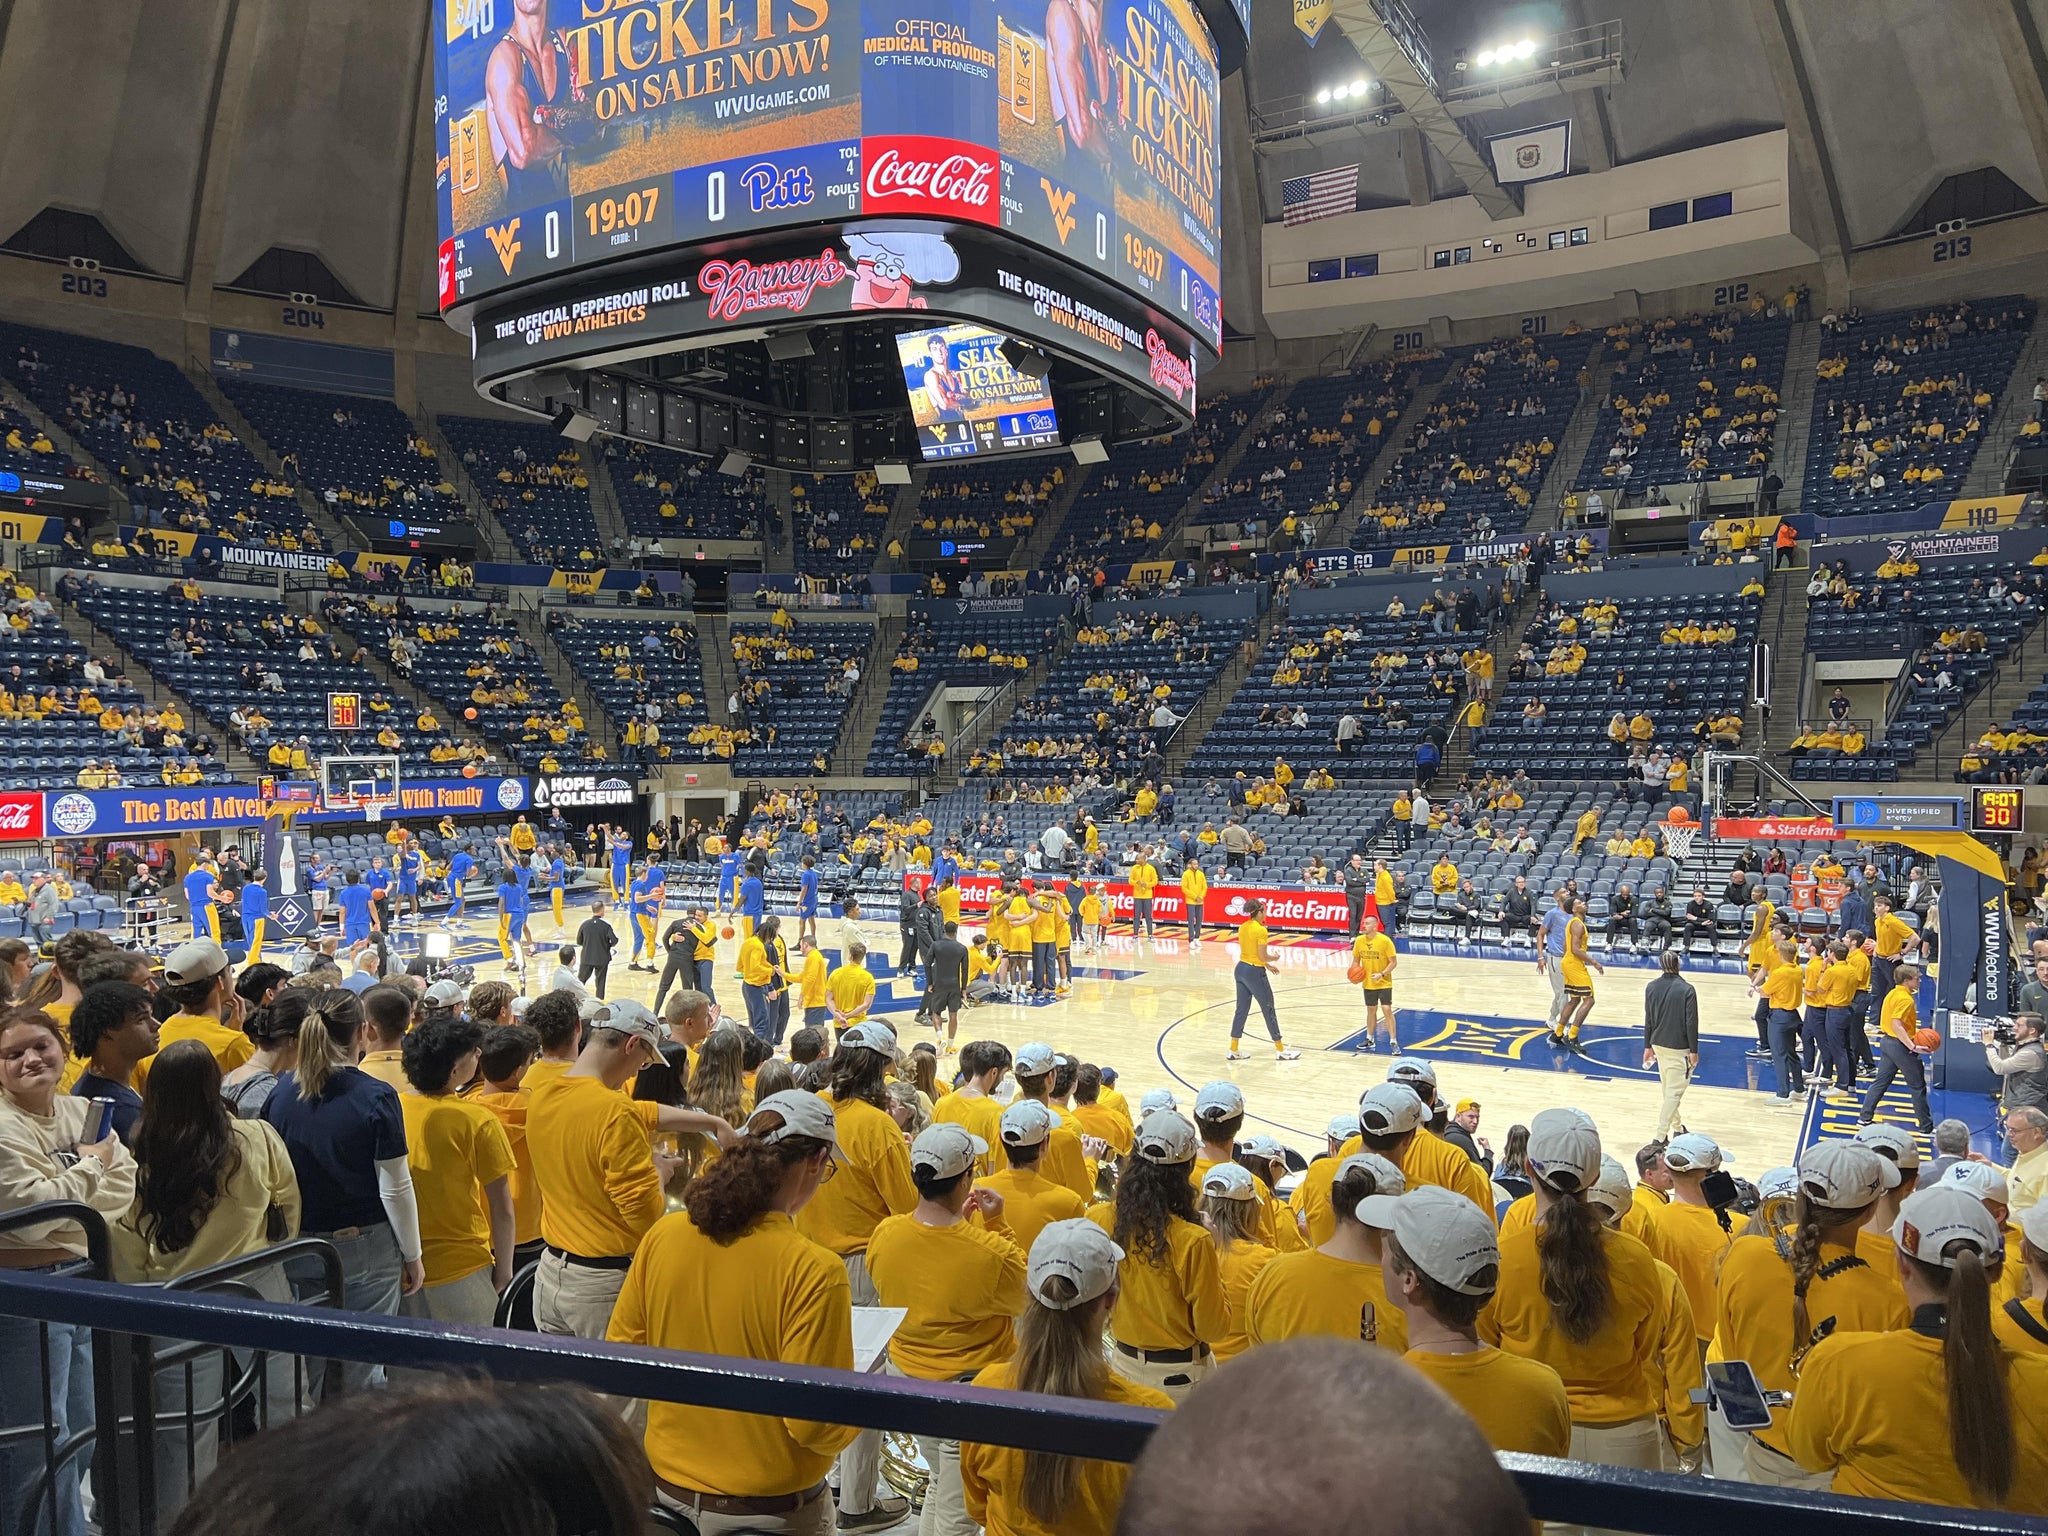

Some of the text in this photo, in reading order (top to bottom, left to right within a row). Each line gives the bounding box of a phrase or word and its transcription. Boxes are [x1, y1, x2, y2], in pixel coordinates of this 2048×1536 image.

[895, 19, 972, 44] OFFICIAL
[864, 36, 996, 69] MEDICAL PROVIDER
[874, 55, 989, 79] OF THE MOUNTAINEERS
[595, 34, 830, 120] ON SALE NOW!
[1125, 6, 1213, 149] SEASON
[714, 84, 831, 118] WVUGAME.COM
[1115, 55, 1215, 200] TICKETS
[839, 146, 860, 159] TOL
[846, 159, 855, 175] 4
[1000, 160, 1014, 176] TOL
[740, 162, 815, 212] Pitt
[866, 149, 996, 207] Coca-Cola
[1005, 175, 1012, 191] 4
[1132, 136, 1214, 234] ON SALE NOW!
[707, 170, 726, 222] 0
[826, 182, 860, 197] FOULS
[848, 193, 856, 210] 0
[1000, 195, 1023, 213] FOULS
[585, 187, 659, 236] 19:07
[1006, 210, 1012, 226] 0
[545, 210, 560, 259] 0
[1095, 211, 1107, 260] 0
[455, 237, 466, 251] TOL
[1933, 236, 1972, 262] 213
[457, 249, 463, 265] 4
[1123, 232, 1164, 283] 19:07
[455, 266, 473, 281] FOULS
[61, 273, 108, 298] 203
[699, 247, 847, 321] Barney's
[1181, 268, 1189, 312] 0
[1714, 283, 1749, 306] 212
[495, 281, 690, 339] THE OFFICIAL PEPPERONI ROLL
[998, 269, 1144, 349] THE OFFICIAL PEPPERONI ROLL
[283, 307, 325, 330] 204
[526, 304, 647, 345] OF WVU ATHLETICS
[1034, 300, 1123, 352] OF WVU ATHLETICS
[1522, 315, 1548, 335] 211
[1393, 332, 1424, 350] 210
[958, 345, 1007, 369] SEAS
[958, 365, 1036, 389] TICKE
[969, 379, 1042, 399] ON SALE NOW!
[974, 422, 996, 433] 19:07
[1011, 418, 1020, 434] 0
[1027, 414, 1053, 431] Pitt
[958, 424, 968, 440] 0
[1967, 507, 1998, 526] 110
[408, 526, 441, 534] DIVERSIFIED
[156, 540, 179, 557] 02
[957, 543, 986, 551] DIVERSIFIED
[1910, 535, 2000, 551] MOUNTAINEER
[1911, 543, 2000, 557] ATHLETIC CLUB
[222, 546, 334, 572] MOUNTAINEERS
[1311, 553, 1374, 571] LET'S GO
[1407, 549, 1436, 566] 108
[1140, 569, 1162, 583] 107
[813, 581, 827, 594] 10
[970, 599, 1024, 608] MOUNTAINEER
[333, 696, 356, 707] 19:07
[333, 708, 354, 725] 30
[551, 776, 596, 791] HOPE
[401, 788, 436, 810] With
[437, 786, 483, 809] Family
[551, 790, 634, 806] COLISEUM
[1983, 793, 2018, 807] 19:07
[54, 811, 95, 820] LAUNCH
[122, 797, 207, 824] The Best
[1886, 807, 1941, 815] DIVERSIFIED
[1985, 808, 2010, 825] 30
[1777, 823, 1838, 837] State Farm
[960, 885, 985, 903] tate
[1108, 891, 1178, 912] ate rm
[1798, 888, 1809, 900] G
[1305, 899, 1350, 921] Farm
